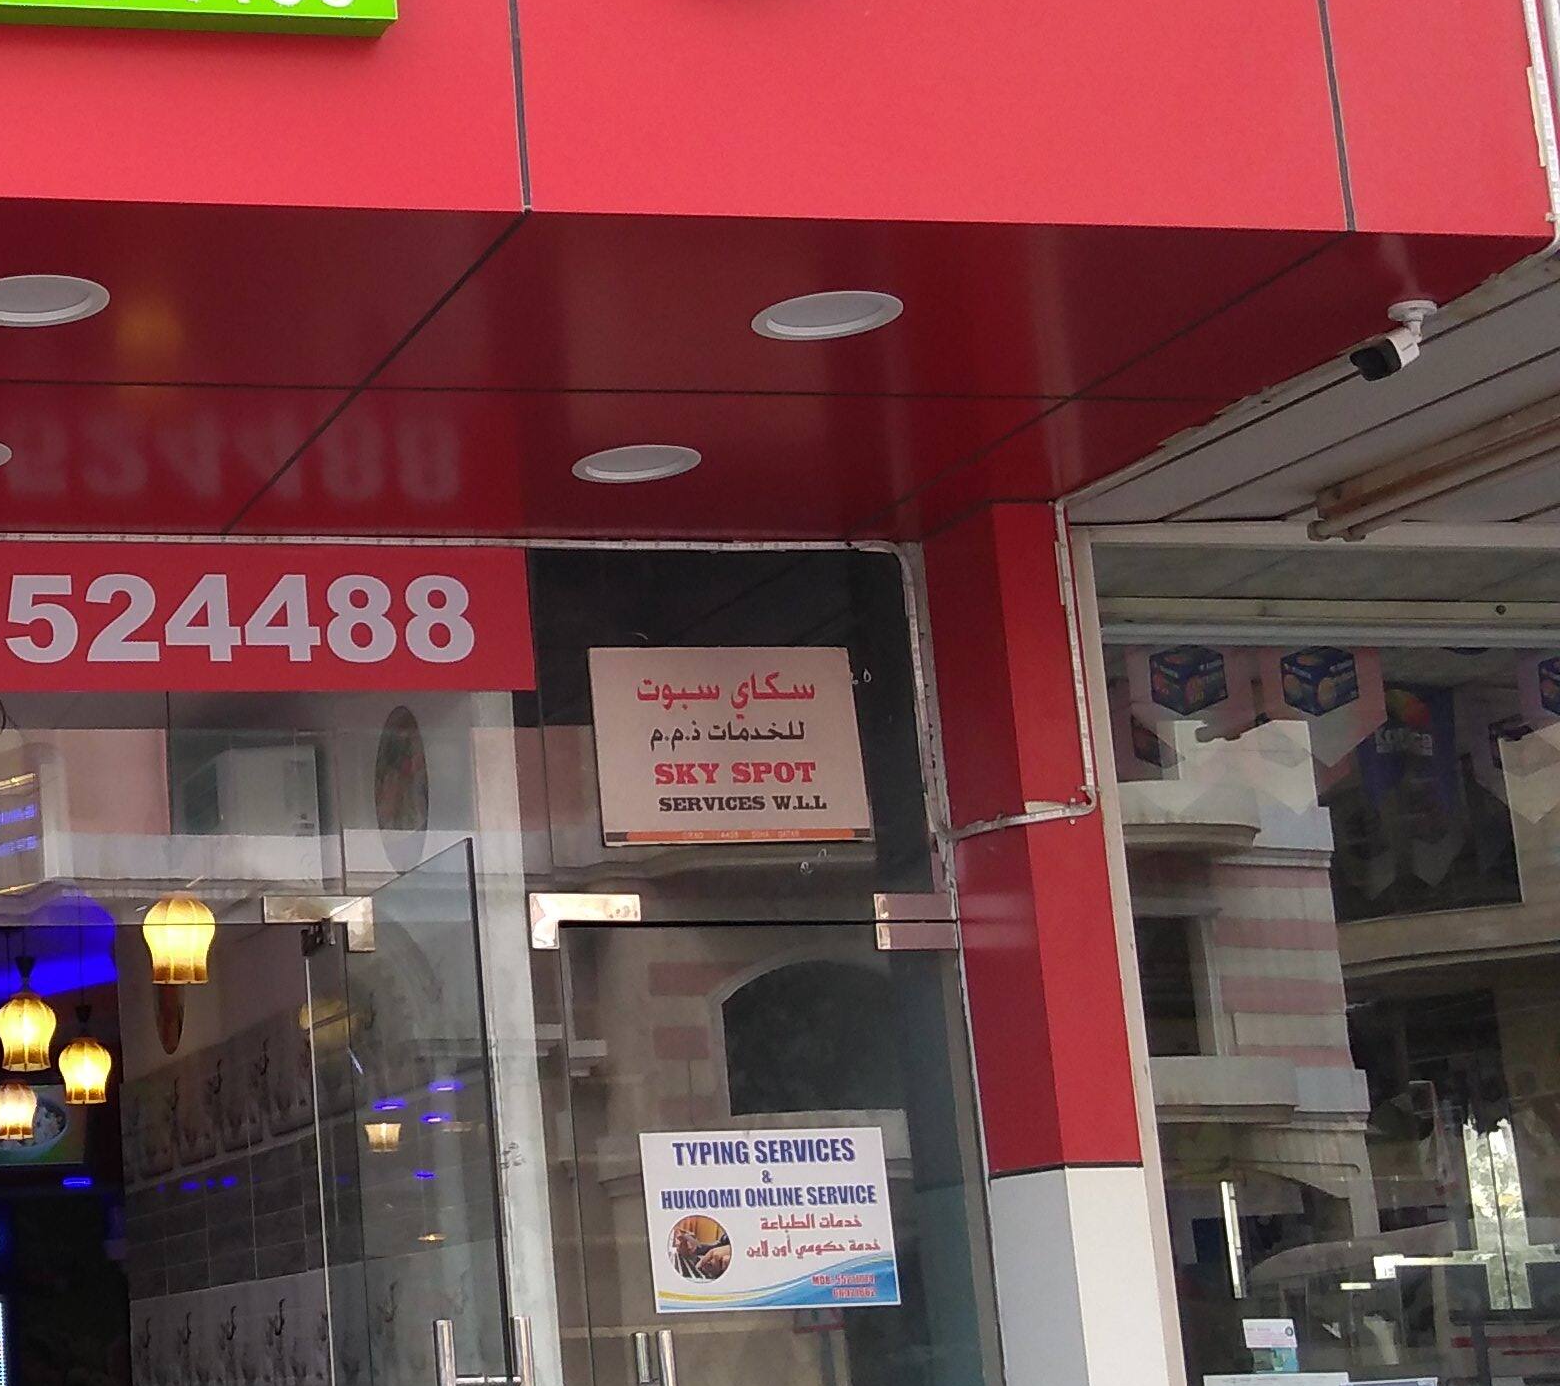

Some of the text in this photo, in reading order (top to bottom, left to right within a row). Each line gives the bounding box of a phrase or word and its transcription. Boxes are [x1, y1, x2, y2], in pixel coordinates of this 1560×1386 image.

[637, 677, 720, 710] سبوت
[730, 671, 815, 720] سكاي
[708, 720, 805, 741] للخدمات
[654, 761, 817, 785] SKY SPOT
[659, 795, 827, 812] SERVICES W.L.L
[672, 1138, 856, 1165] TYPING SERVICES
[761, 1170, 772, 1183] &
[661, 1185, 877, 1209] HUKOOMI ONLINE SERVICE
[760, 1213, 862, 1232] خدمات الطباعة
[795, 1240, 845, 1259] حكومي
[848, 1238, 881, 1251] خدمة
